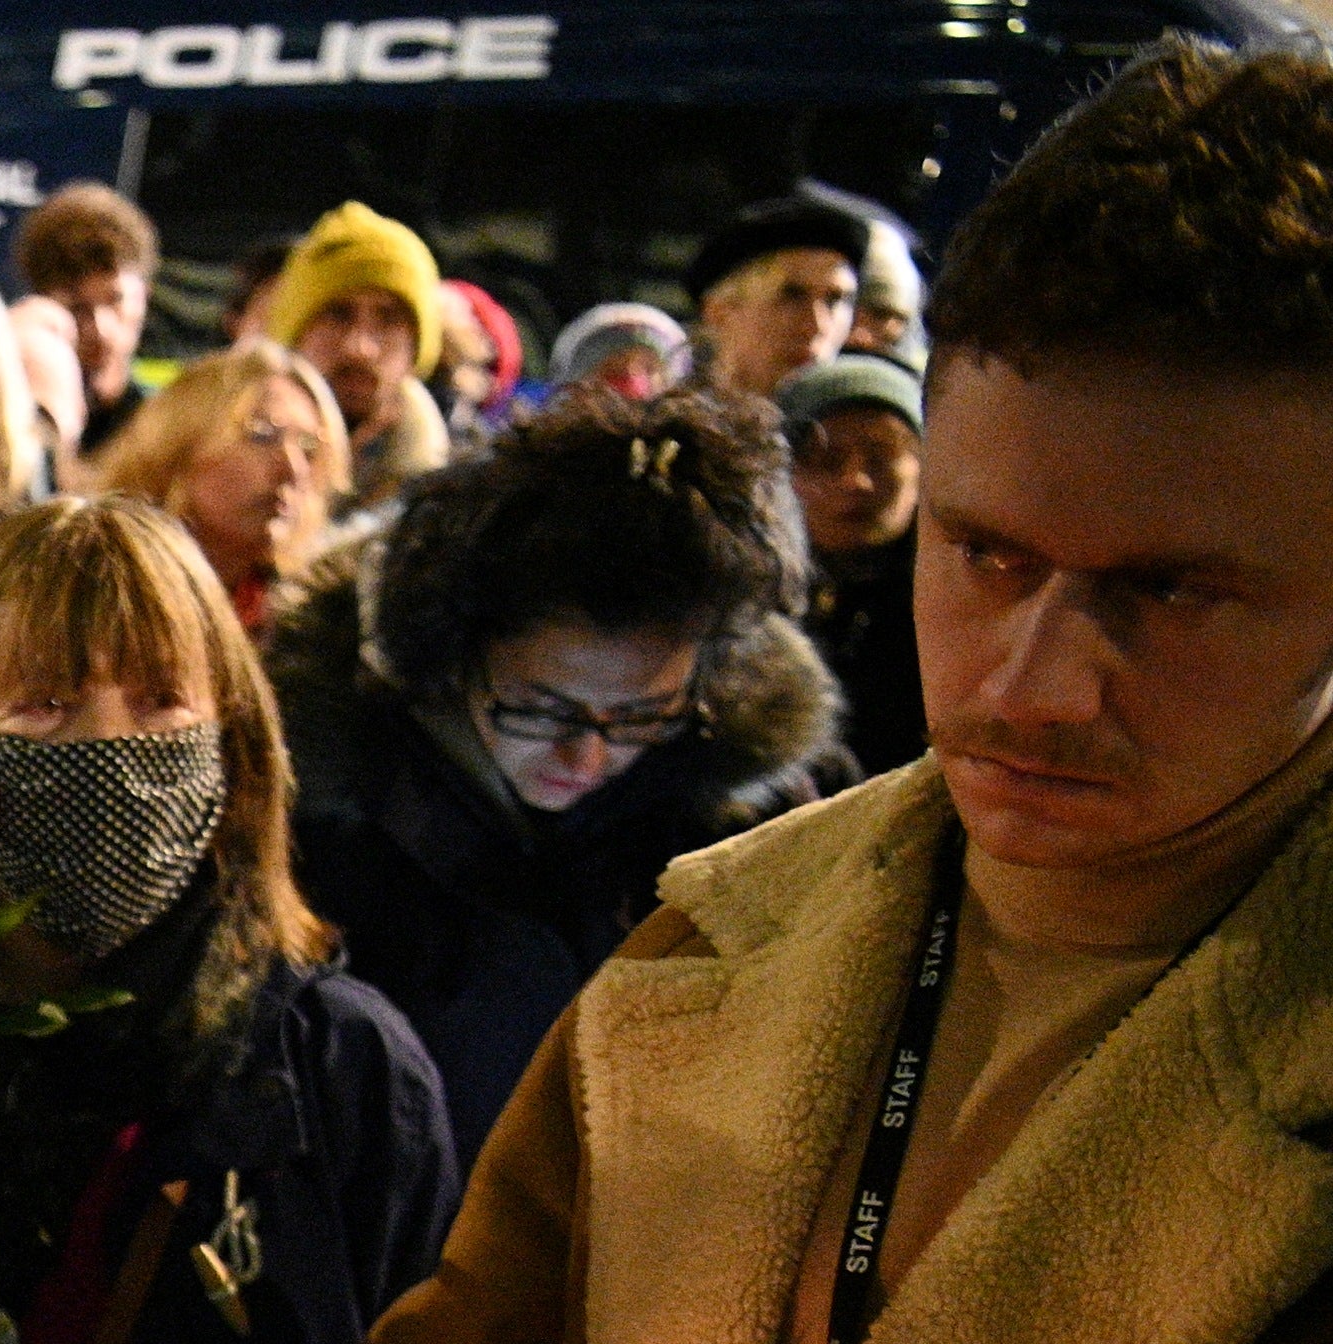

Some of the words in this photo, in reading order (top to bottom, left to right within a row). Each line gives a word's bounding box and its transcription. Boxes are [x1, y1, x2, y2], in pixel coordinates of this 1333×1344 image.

[52, 16, 558, 90] POLICE
[919, 909, 950, 988] STAFF
[882, 1048, 921, 1129] STAFF
[845, 1189, 884, 1274] STAFF
